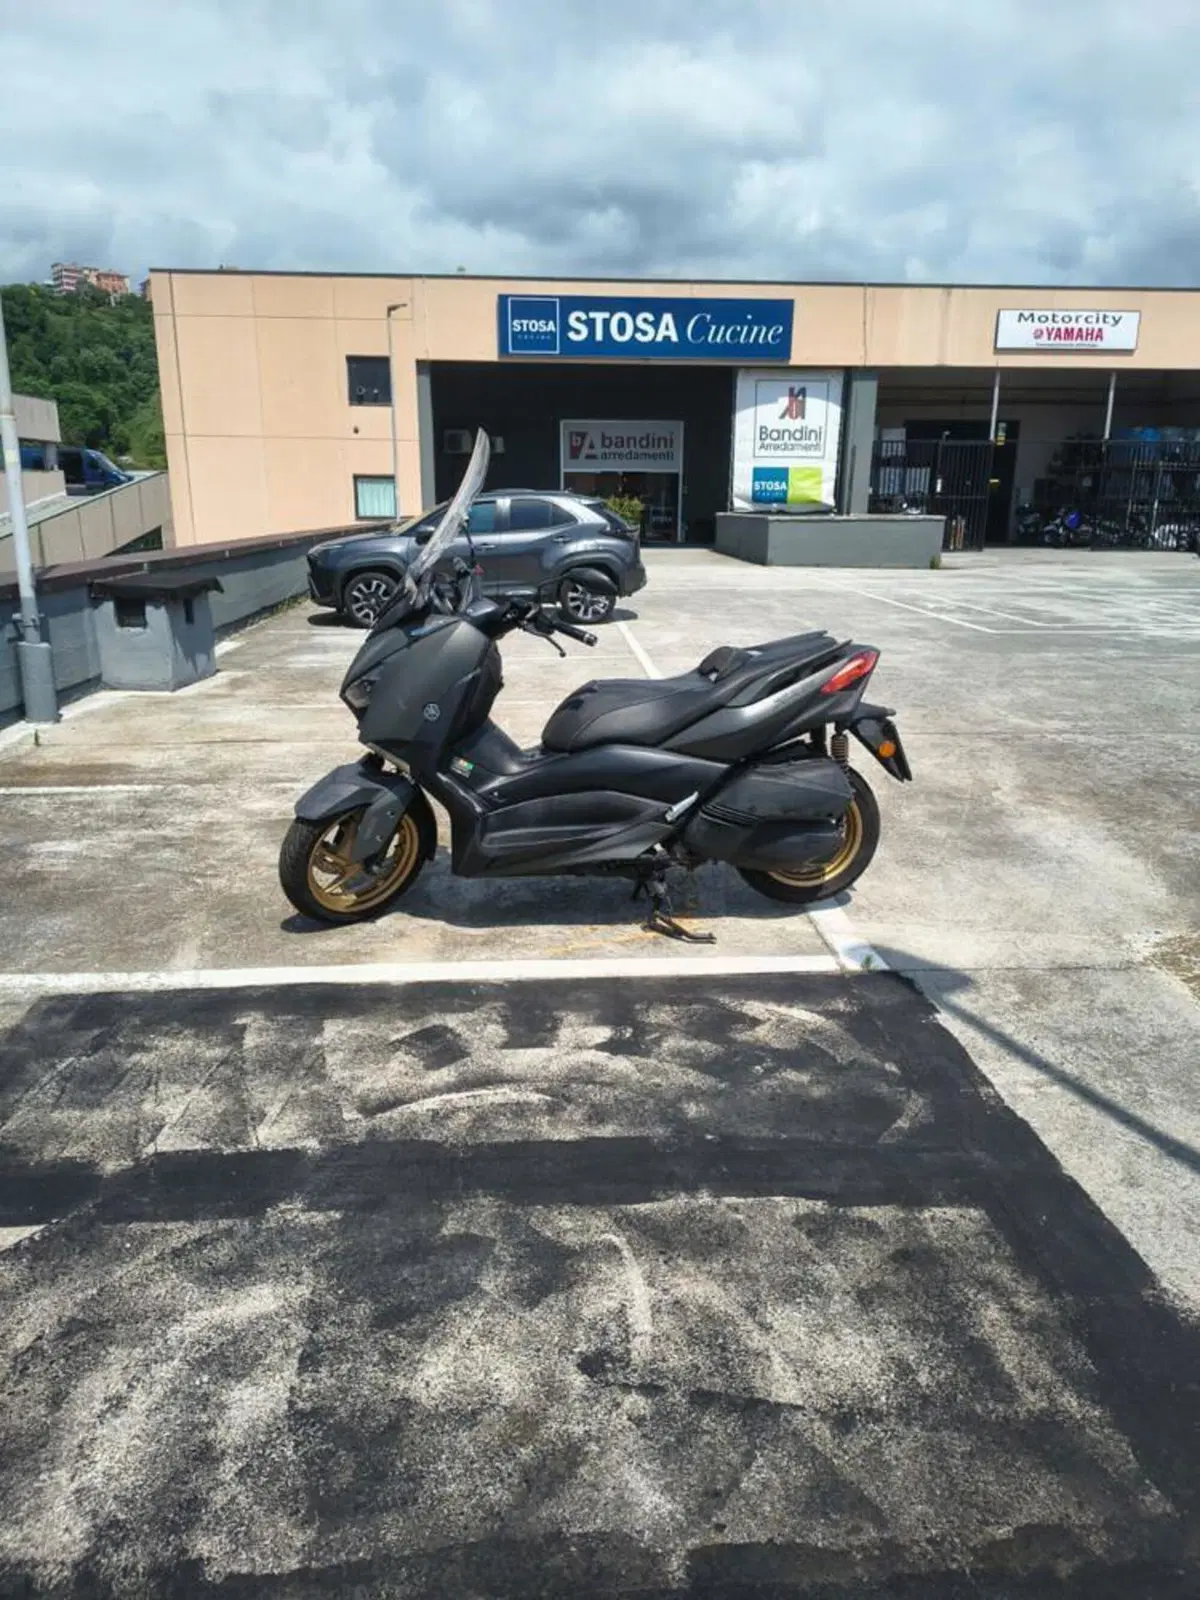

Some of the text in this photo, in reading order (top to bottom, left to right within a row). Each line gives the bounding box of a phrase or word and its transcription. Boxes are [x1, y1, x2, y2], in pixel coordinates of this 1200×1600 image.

[512, 319, 556, 332] STOSA
[1017, 312, 1122, 327] Motorcity
[567, 311, 784, 345] STOSA Cucine
[1046, 327, 1104, 342] YAMAHA
[601, 431, 675, 449] bandini
[759, 425, 823, 441] Bandini
[759, 441, 822, 452] Arredamenti
[601, 450, 675, 461] arredamenti
[754, 481, 788, 491] STOSA
